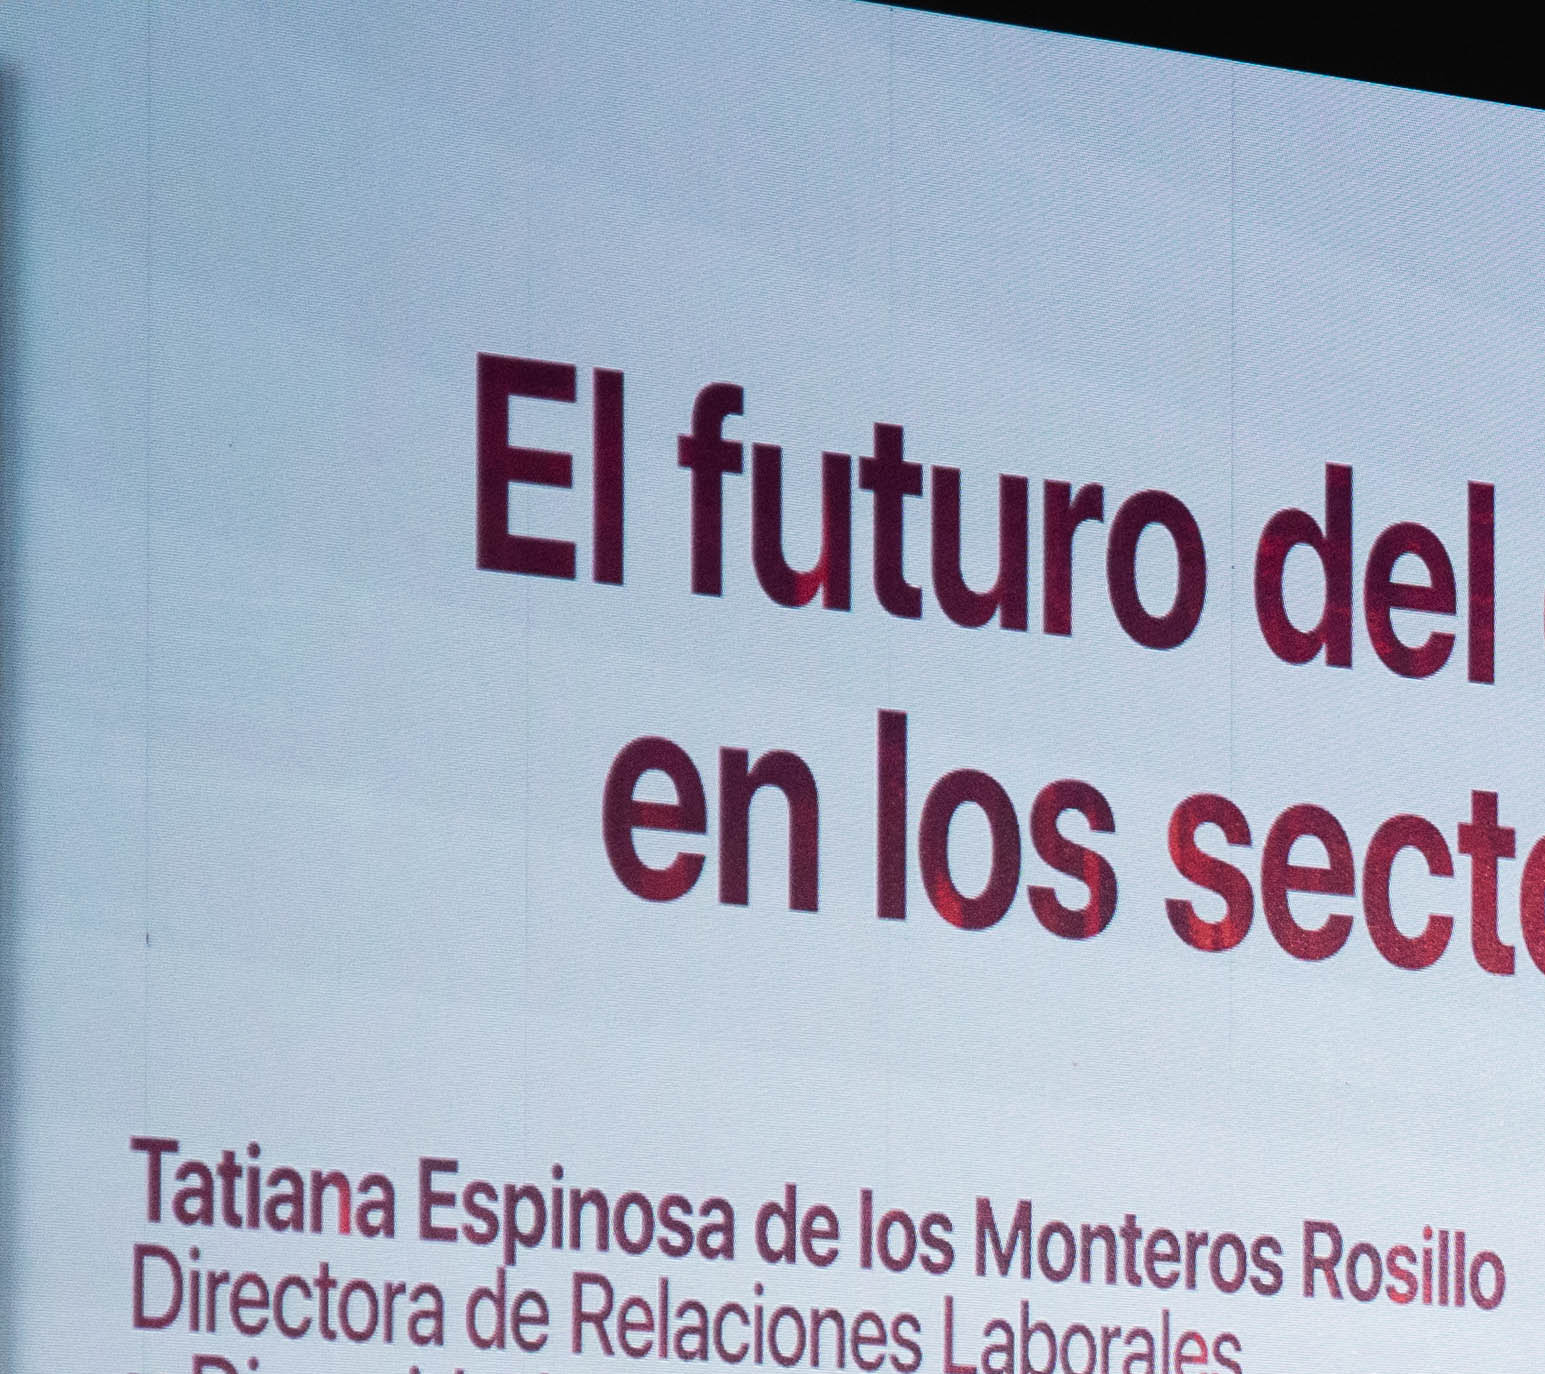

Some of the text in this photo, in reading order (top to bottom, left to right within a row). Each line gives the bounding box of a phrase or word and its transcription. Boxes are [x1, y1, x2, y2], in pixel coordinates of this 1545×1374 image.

[475, 352, 626, 587] El
[676, 381, 1209, 651] futuro
[1253, 462, 1497, 685] del
[601, 735, 820, 914] en
[876, 708, 1119, 941] los
[130, 1136, 1506, 1311] Tatiana Espinosa de los Monteros Rosillo
[133, 1243, 445, 1347] Directora
[466, 1267, 550, 1353] de
[572, 1271, 923, 1374] Relaciones
